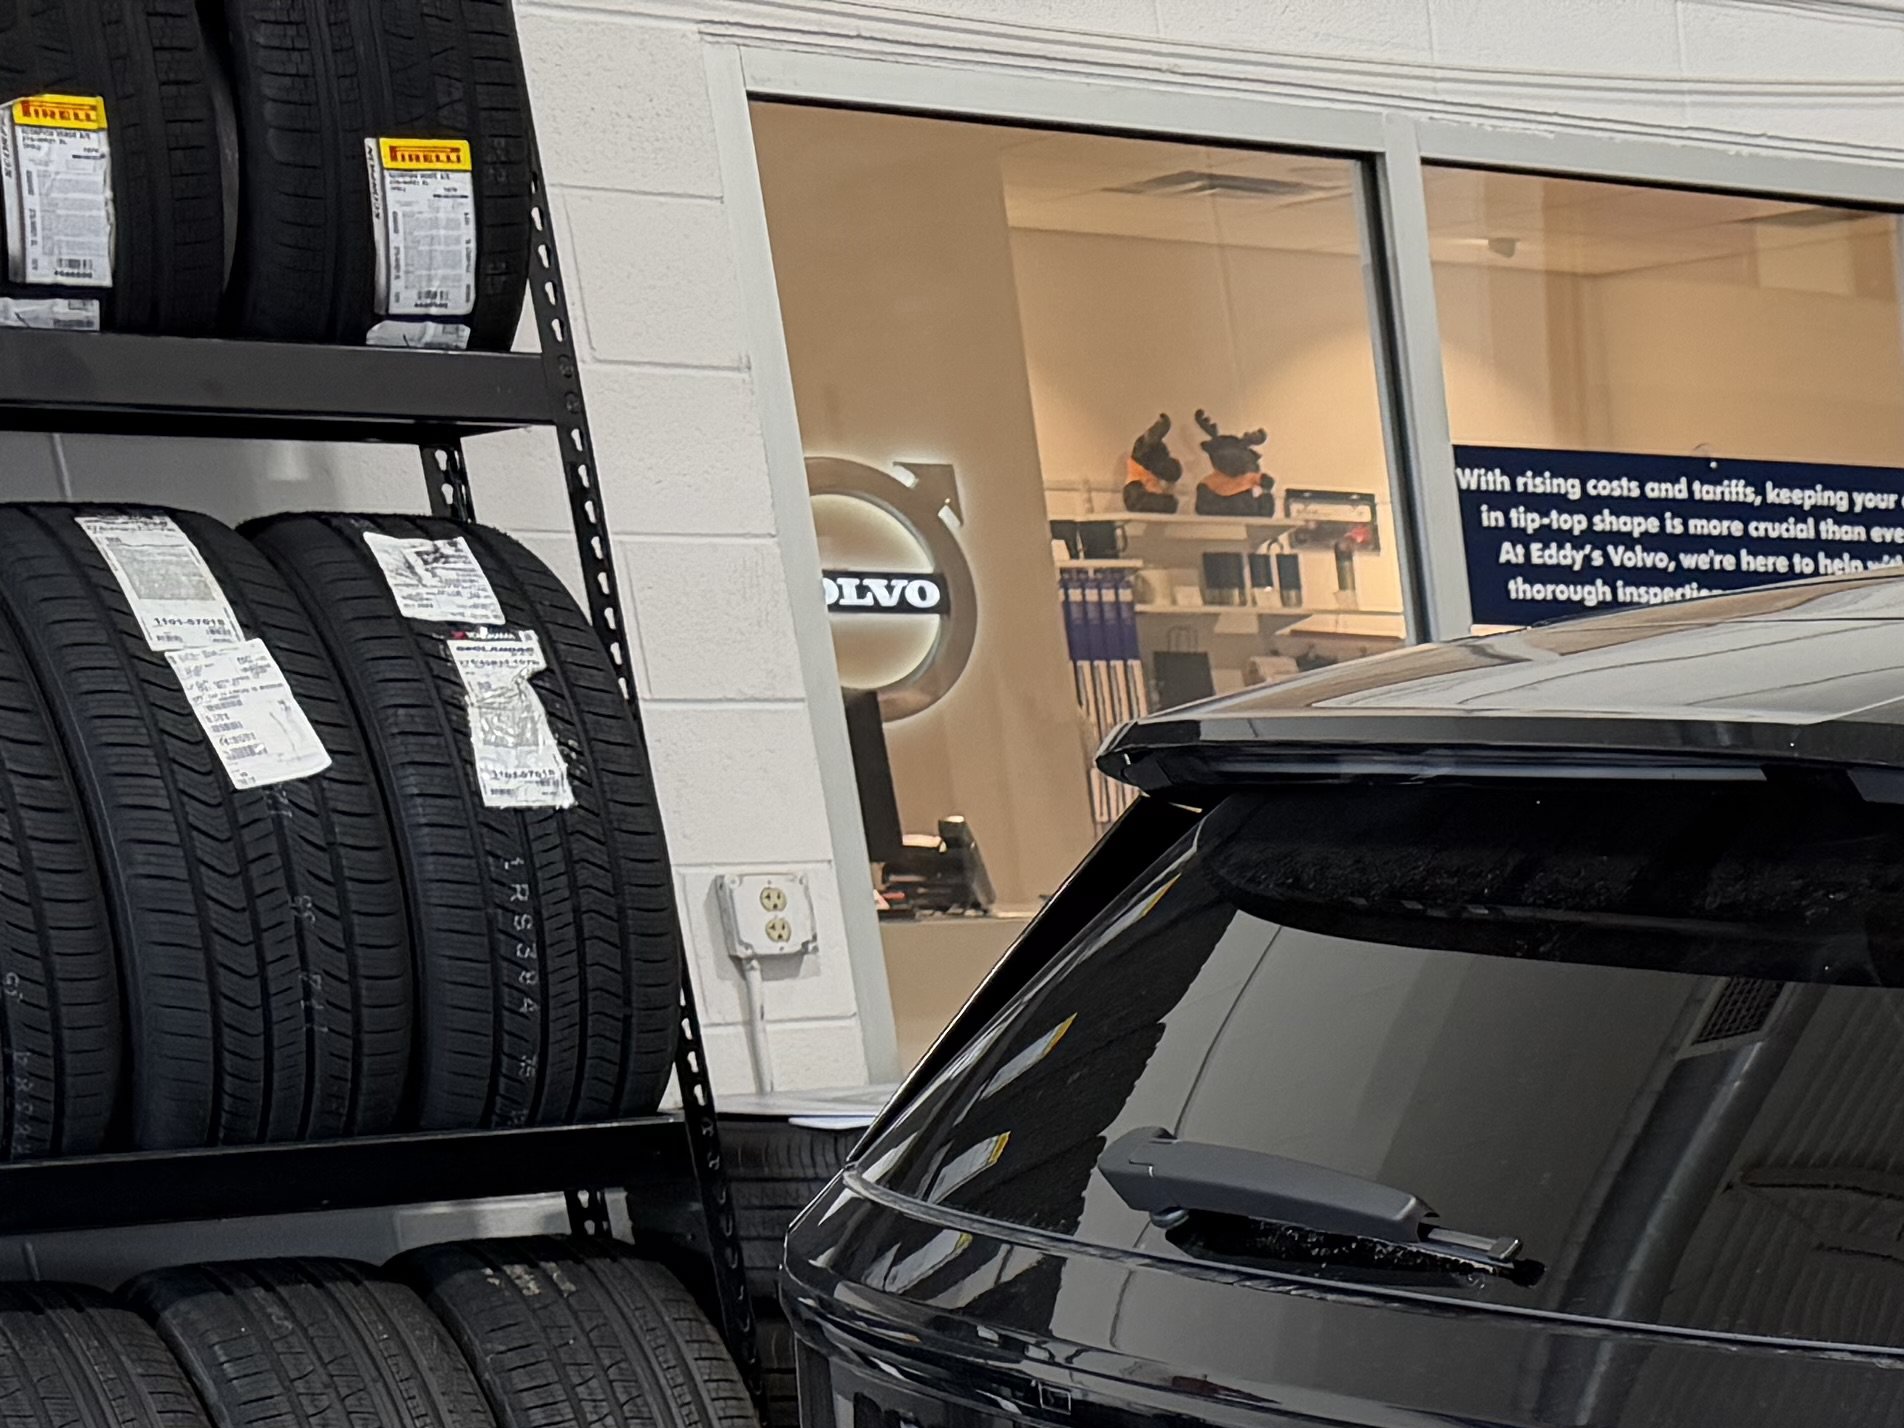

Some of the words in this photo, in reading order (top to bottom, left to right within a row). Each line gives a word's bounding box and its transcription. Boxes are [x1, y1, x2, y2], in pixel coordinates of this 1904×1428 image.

[389, 145, 462, 164] PIRELLI
[1455, 468, 1511, 492] With
[1516, 470, 1581, 500] rising
[1586, 477, 1641, 498] costs
[1645, 477, 1688, 500] and
[1692, 479, 1763, 507] tariffs,
[1765, 480, 1849, 512] keeping
[1852, 491, 1898, 513] your
[1480, 504, 1505, 528] in
[1509, 506, 1588, 535] tip-top
[1592, 508, 1660, 538] shape
[1664, 511, 1684, 535] is
[1688, 518, 1744, 537] more
[1748, 516, 1815, 540] crucial
[1819, 518, 1867, 541] than
[1499, 541, 1525, 564] At
[1529, 542, 1604, 572] Eddy's
[1606, 544, 1676, 573] Volvo,
[1678, 549, 1737, 572] we're
[1740, 548, 1789, 574] here
[1792, 553, 1815, 574] to
[1508, 576, 1612, 607] thorough
